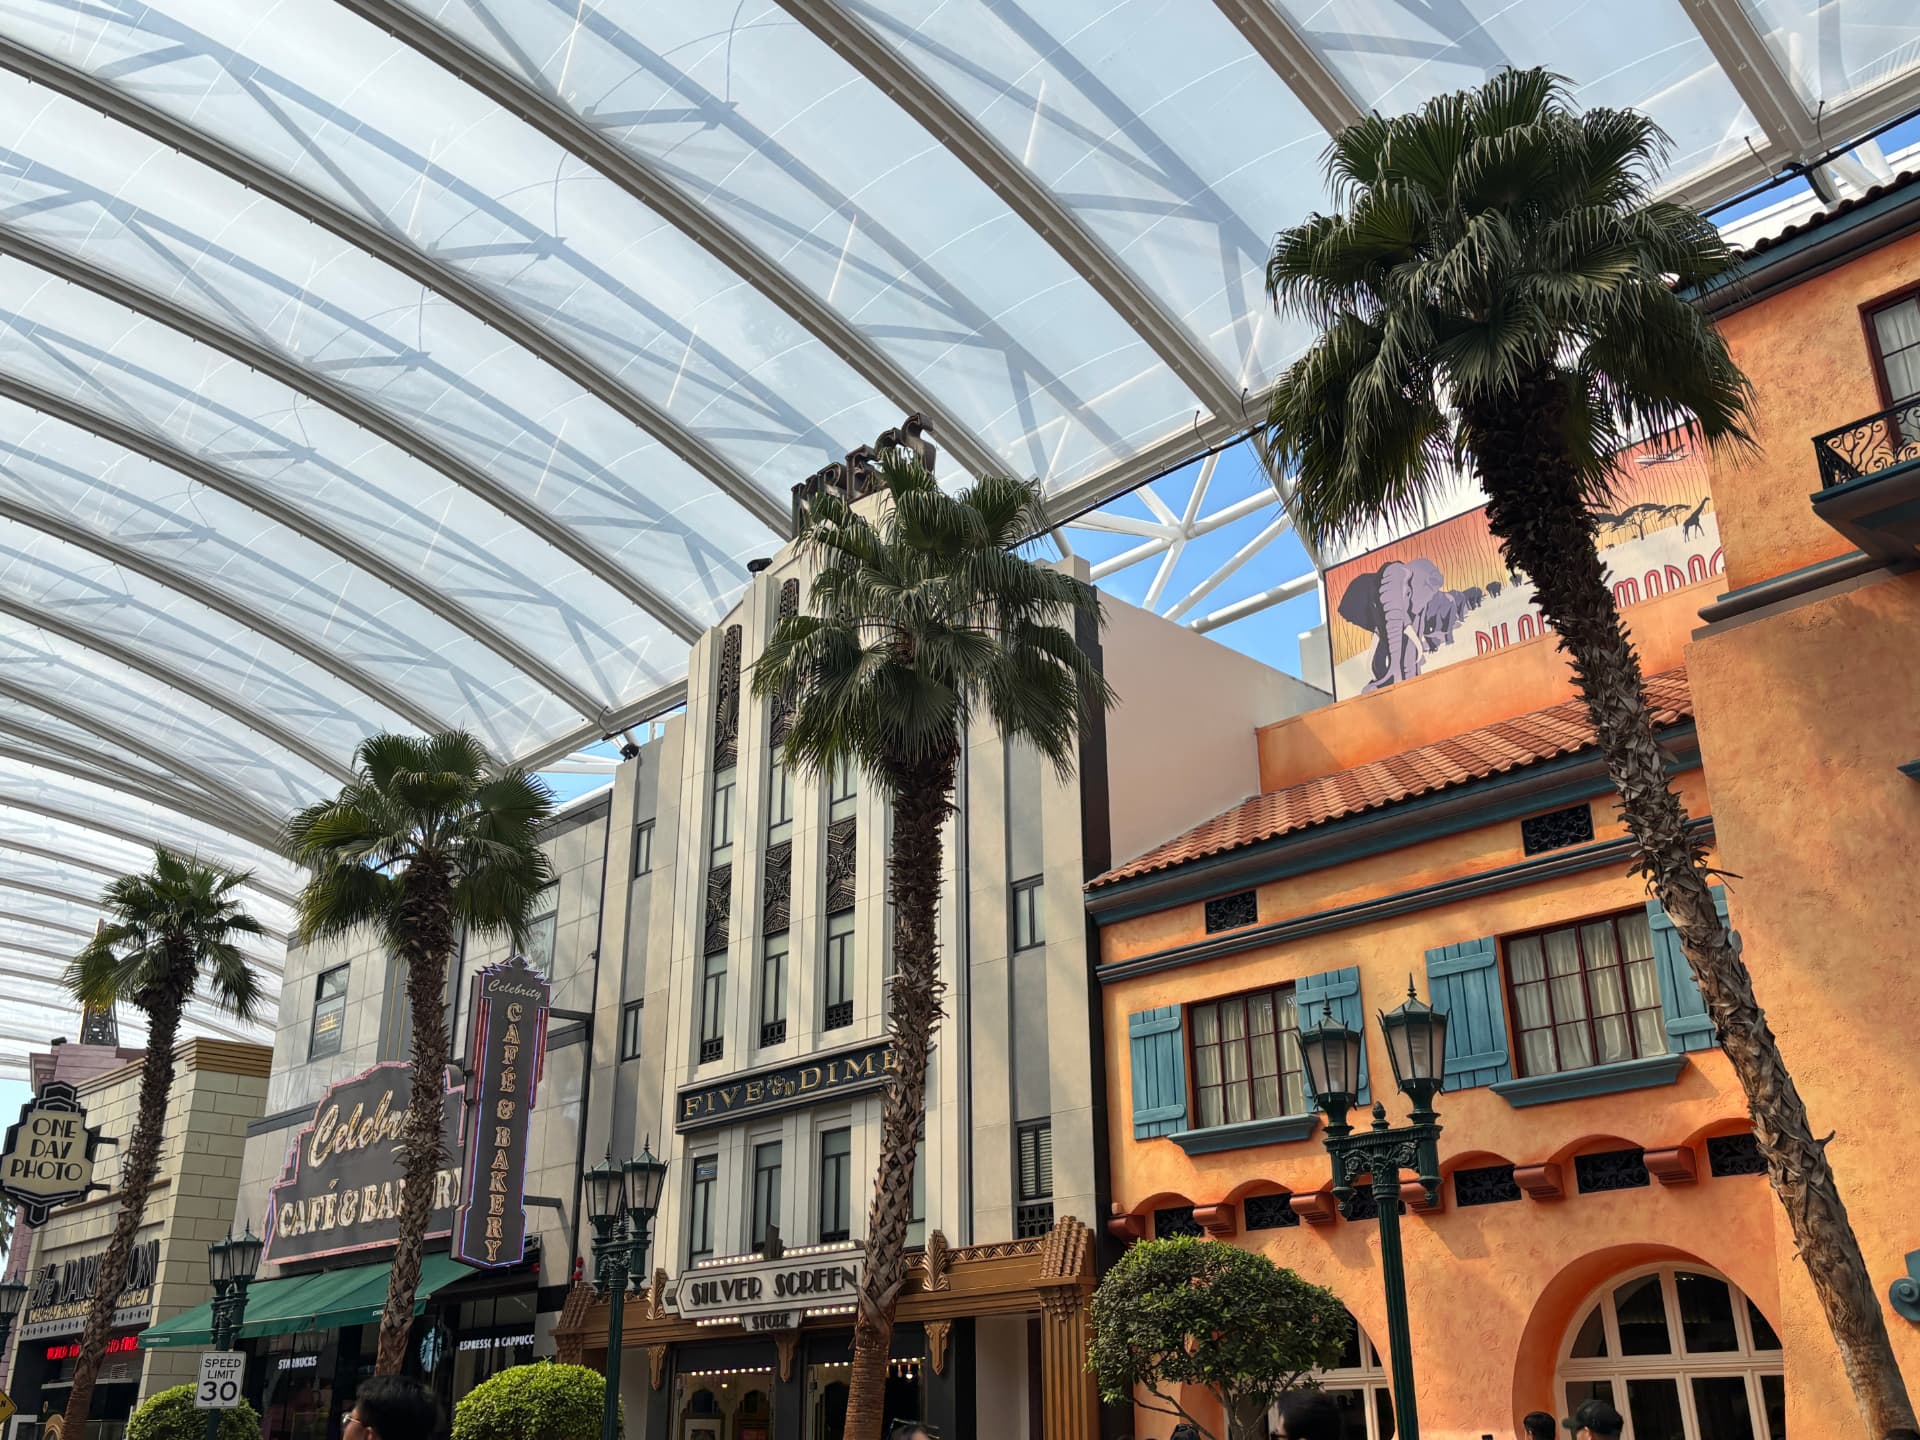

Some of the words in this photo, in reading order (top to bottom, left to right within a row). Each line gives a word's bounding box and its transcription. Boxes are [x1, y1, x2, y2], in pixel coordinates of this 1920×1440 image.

[488, 979, 542, 1001] Celebrity
[500, 1002, 523, 1093] CAFÉ
[684, 1079, 765, 1119] FIVE
[799, 1048, 898, 1090] DIME
[32, 1118, 78, 1138] ONE
[307, 1089, 444, 1168] Celebr
[30, 1139, 72, 1159] DAY
[10, 1159, 83, 1181] PHOTO
[278, 1178, 339, 1238] CAFÉ
[337, 1190, 359, 1227] &
[359, 1167, 462, 1224] BARY
[484, 1126, 512, 1262] BAKERY
[690, 1276, 762, 1306] SILVER
[774, 1264, 857, 1298] SCREEN
[751, 1312, 791, 1329] STORE
[204, 1358, 241, 1367] SPEED
[278, 1355, 318, 1370] STARBUCKS
[207, 1370, 235, 1379] LIMIT
[200, 1381, 237, 1401] 30
